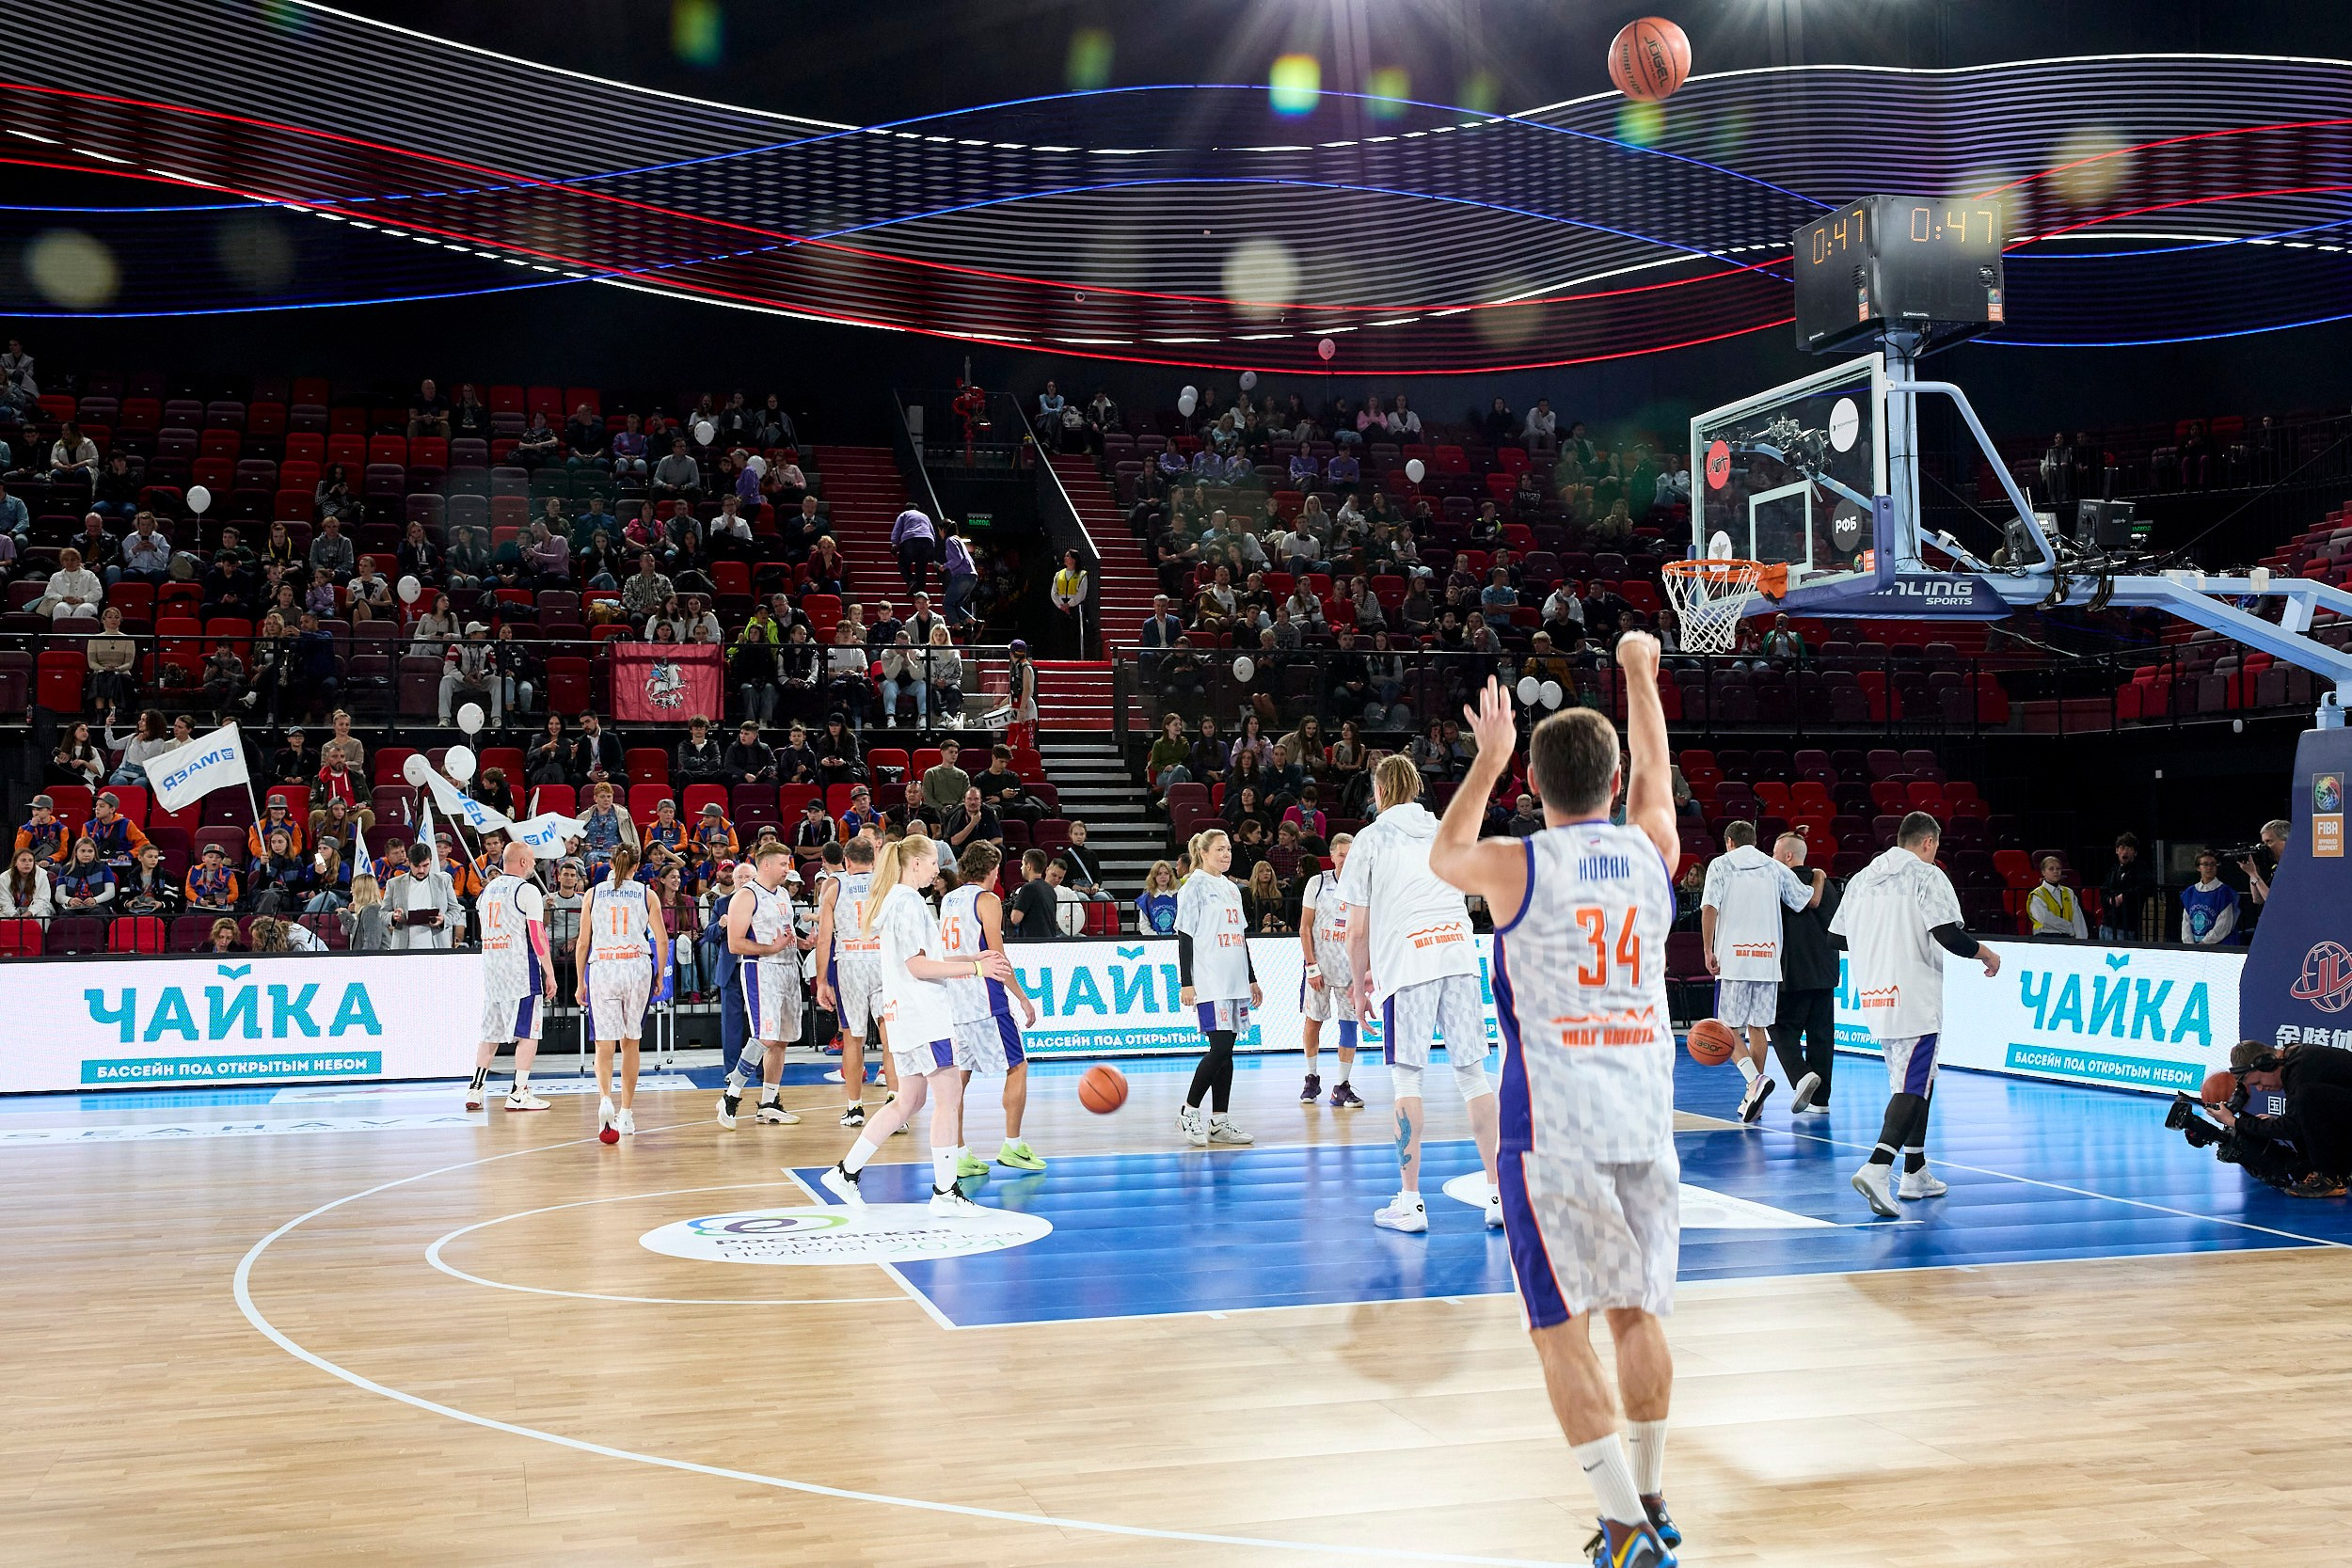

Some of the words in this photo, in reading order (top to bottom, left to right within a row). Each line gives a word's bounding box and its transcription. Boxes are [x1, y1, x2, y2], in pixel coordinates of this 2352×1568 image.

[1644, 37, 1669, 88] JÖGEL
[1813, 209, 1864, 265] 0:47
[1911, 207, 1993, 244] 0:47
[1836, 515, 1857, 534] РФБ
[1868, 581, 1973, 595] NLING
[2317, 821, 2338, 835] FIBA
[1579, 855, 1630, 882] НОВАК
[487, 901, 502, 928] 12
[610, 906, 629, 937] 11
[1226, 909, 1239, 926] 23
[942, 916, 961, 950] 45
[1217, 933, 1232, 948] 12
[1332, 930, 1346, 942] MA
[1414, 938, 1434, 949] ШАГ
[1575, 904, 1642, 990] 34
[84, 963, 383, 1043] ЧАЙКА
[2020, 952, 2213, 1047] ЧАЙКА
[1026, 1033, 1090, 1049] БАССЕЙН
[1093, 1036, 1121, 1048] ПОД
[1125, 1032, 1200, 1046] ОТКРЫТЫМ
[98, 1062, 173, 1079] БАССЕЙН
[179, 1061, 214, 1077] ПОД
[217, 1059, 310, 1075] ОТКРЫТЫМ
[313, 1058, 368, 1071] НЕБОМ
[2014, 1051, 2061, 1068] БАССЕЙН
[2063, 1058, 2086, 1072] ПОД
[2088, 1060, 2151, 1079] ОТКРЫТЫМ
[2153, 1068, 2194, 1085] НЕБОМ
[2268, 1096, 2286, 1116] 国
[887, 1239, 1009, 1253] 2024
